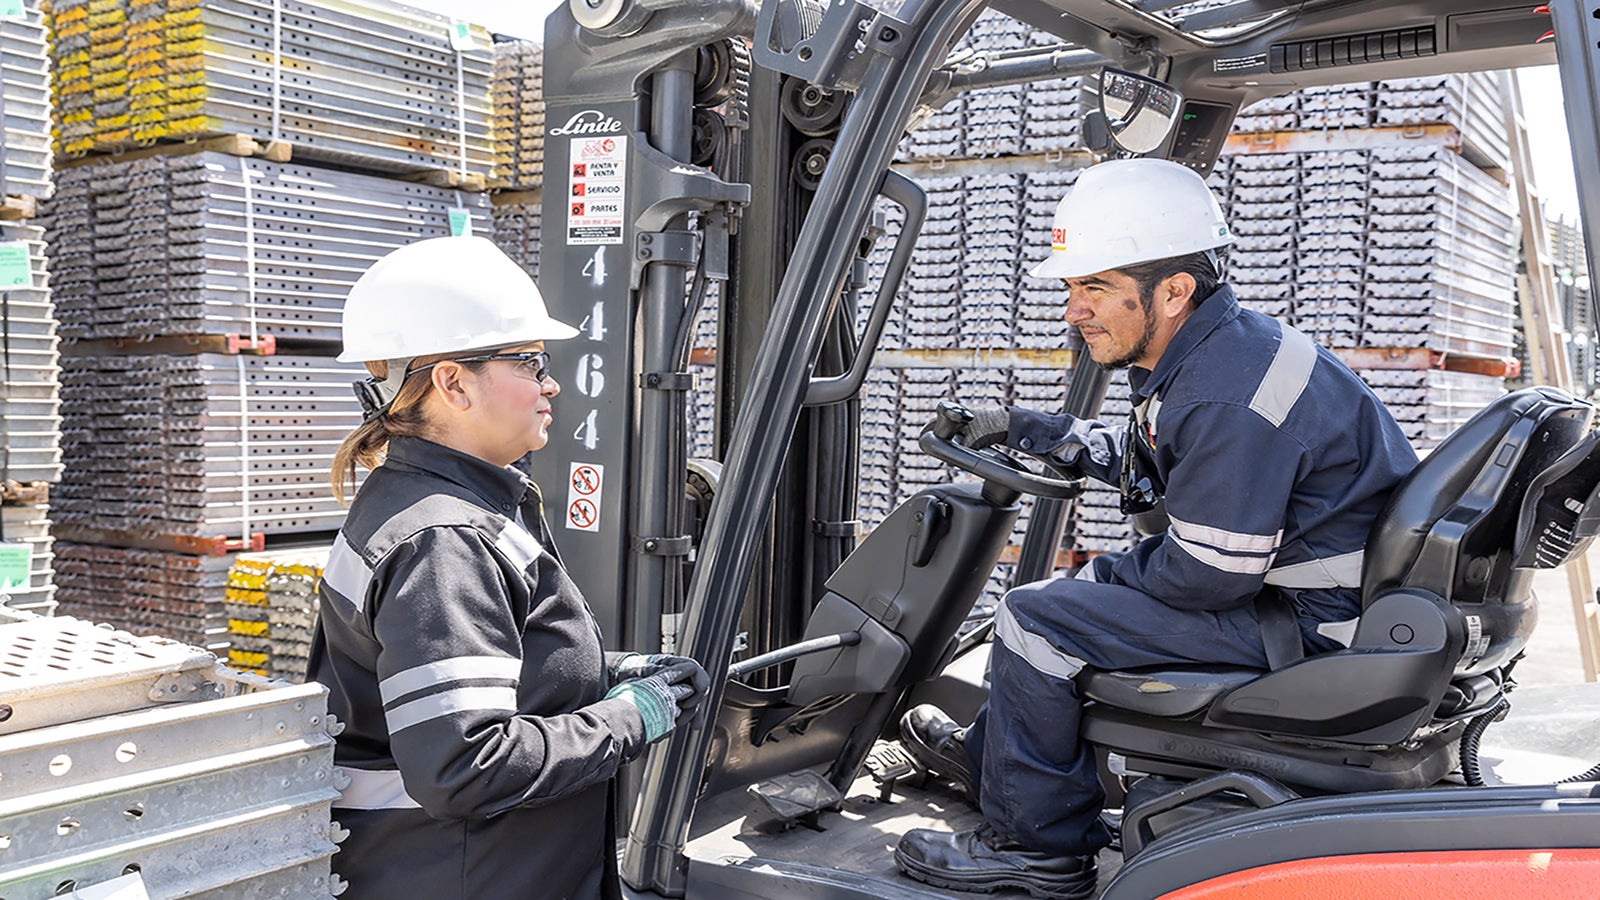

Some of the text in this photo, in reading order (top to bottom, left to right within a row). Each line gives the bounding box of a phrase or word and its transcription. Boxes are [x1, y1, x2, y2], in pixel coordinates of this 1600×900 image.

[549, 110, 622, 136] Linde
[590, 162, 612, 170] RENTA
[593, 169, 615, 177] VENTA
[587, 185, 621, 194] SERVICIO
[590, 204, 618, 212] PARTES
[1051, 228, 1066, 244] ERI
